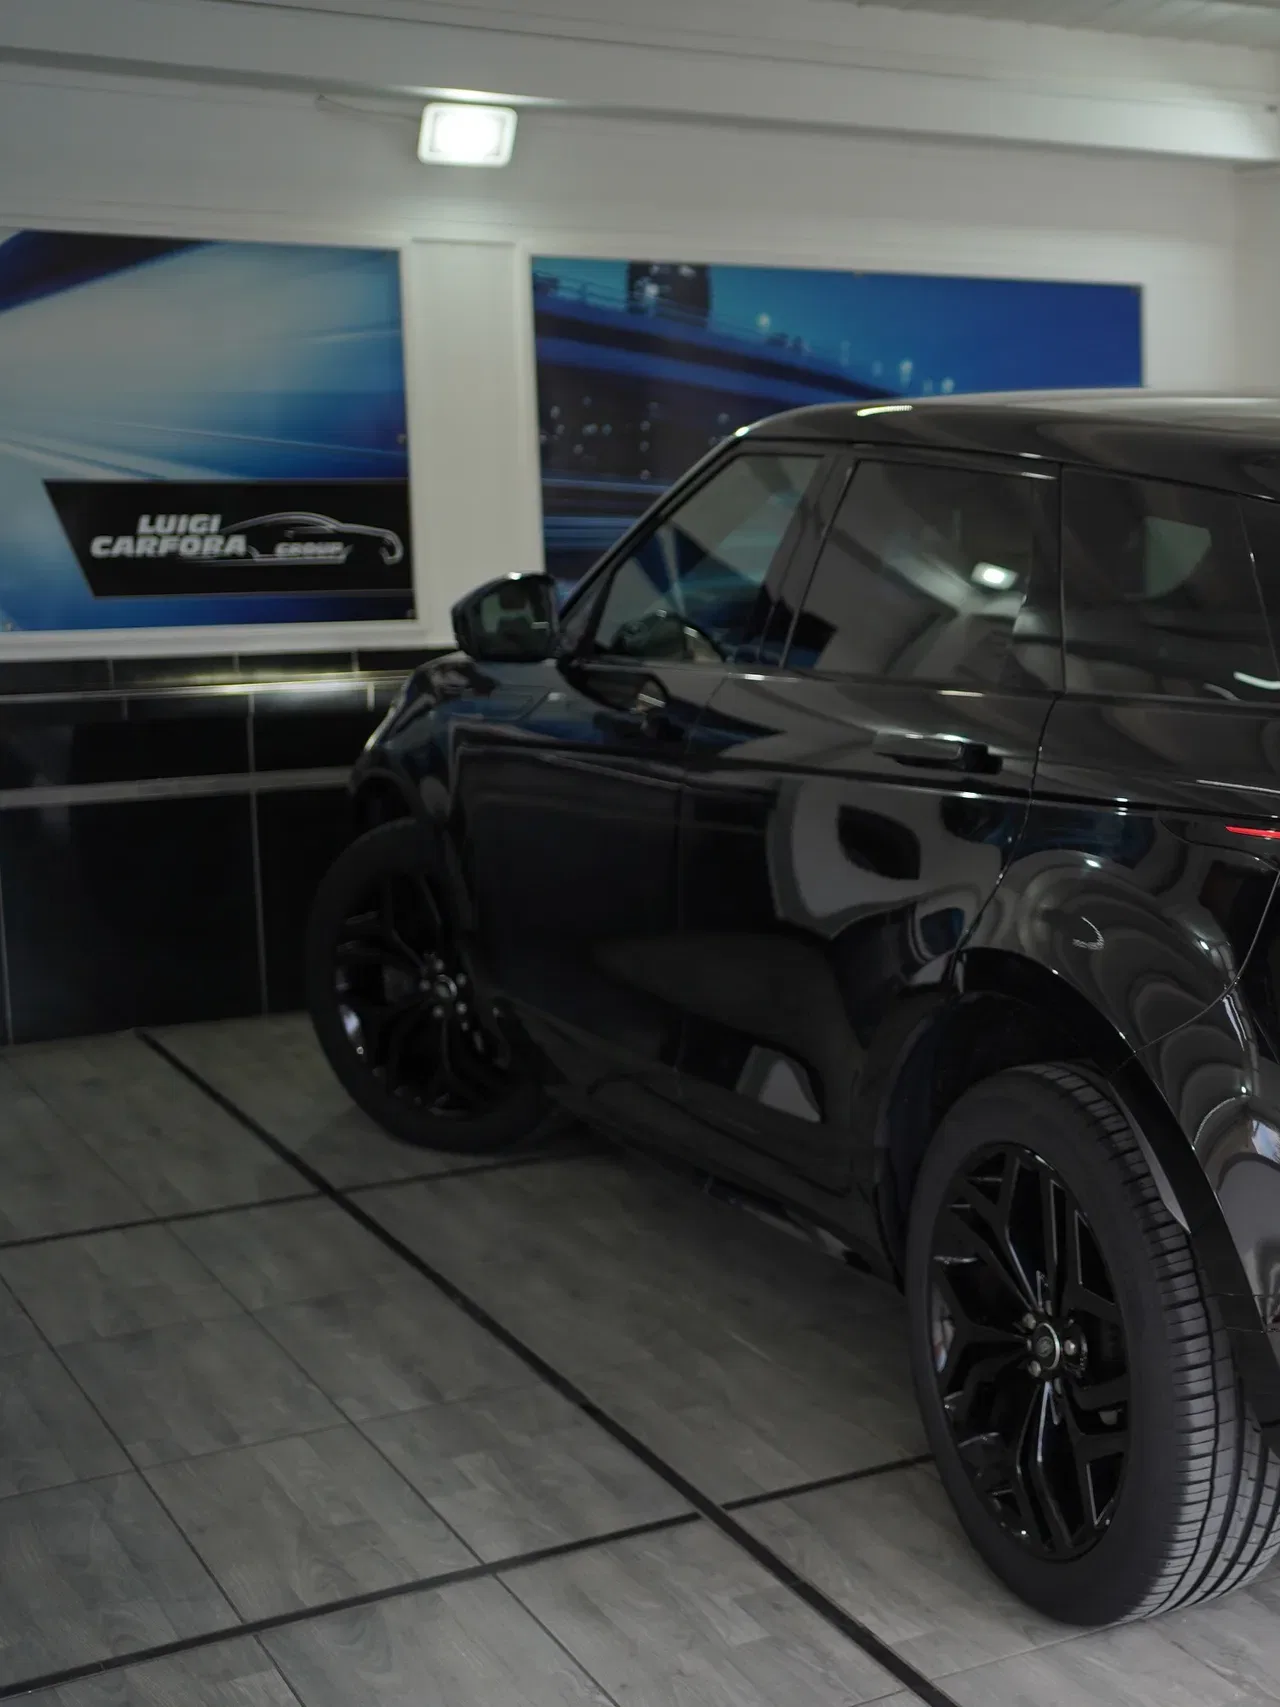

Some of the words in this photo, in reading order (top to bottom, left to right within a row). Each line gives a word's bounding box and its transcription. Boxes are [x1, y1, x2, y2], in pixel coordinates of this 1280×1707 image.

[137, 514, 222, 535] LUIGI
[90, 535, 248, 559] CARFORA
[275, 541, 344, 556] GROUP
